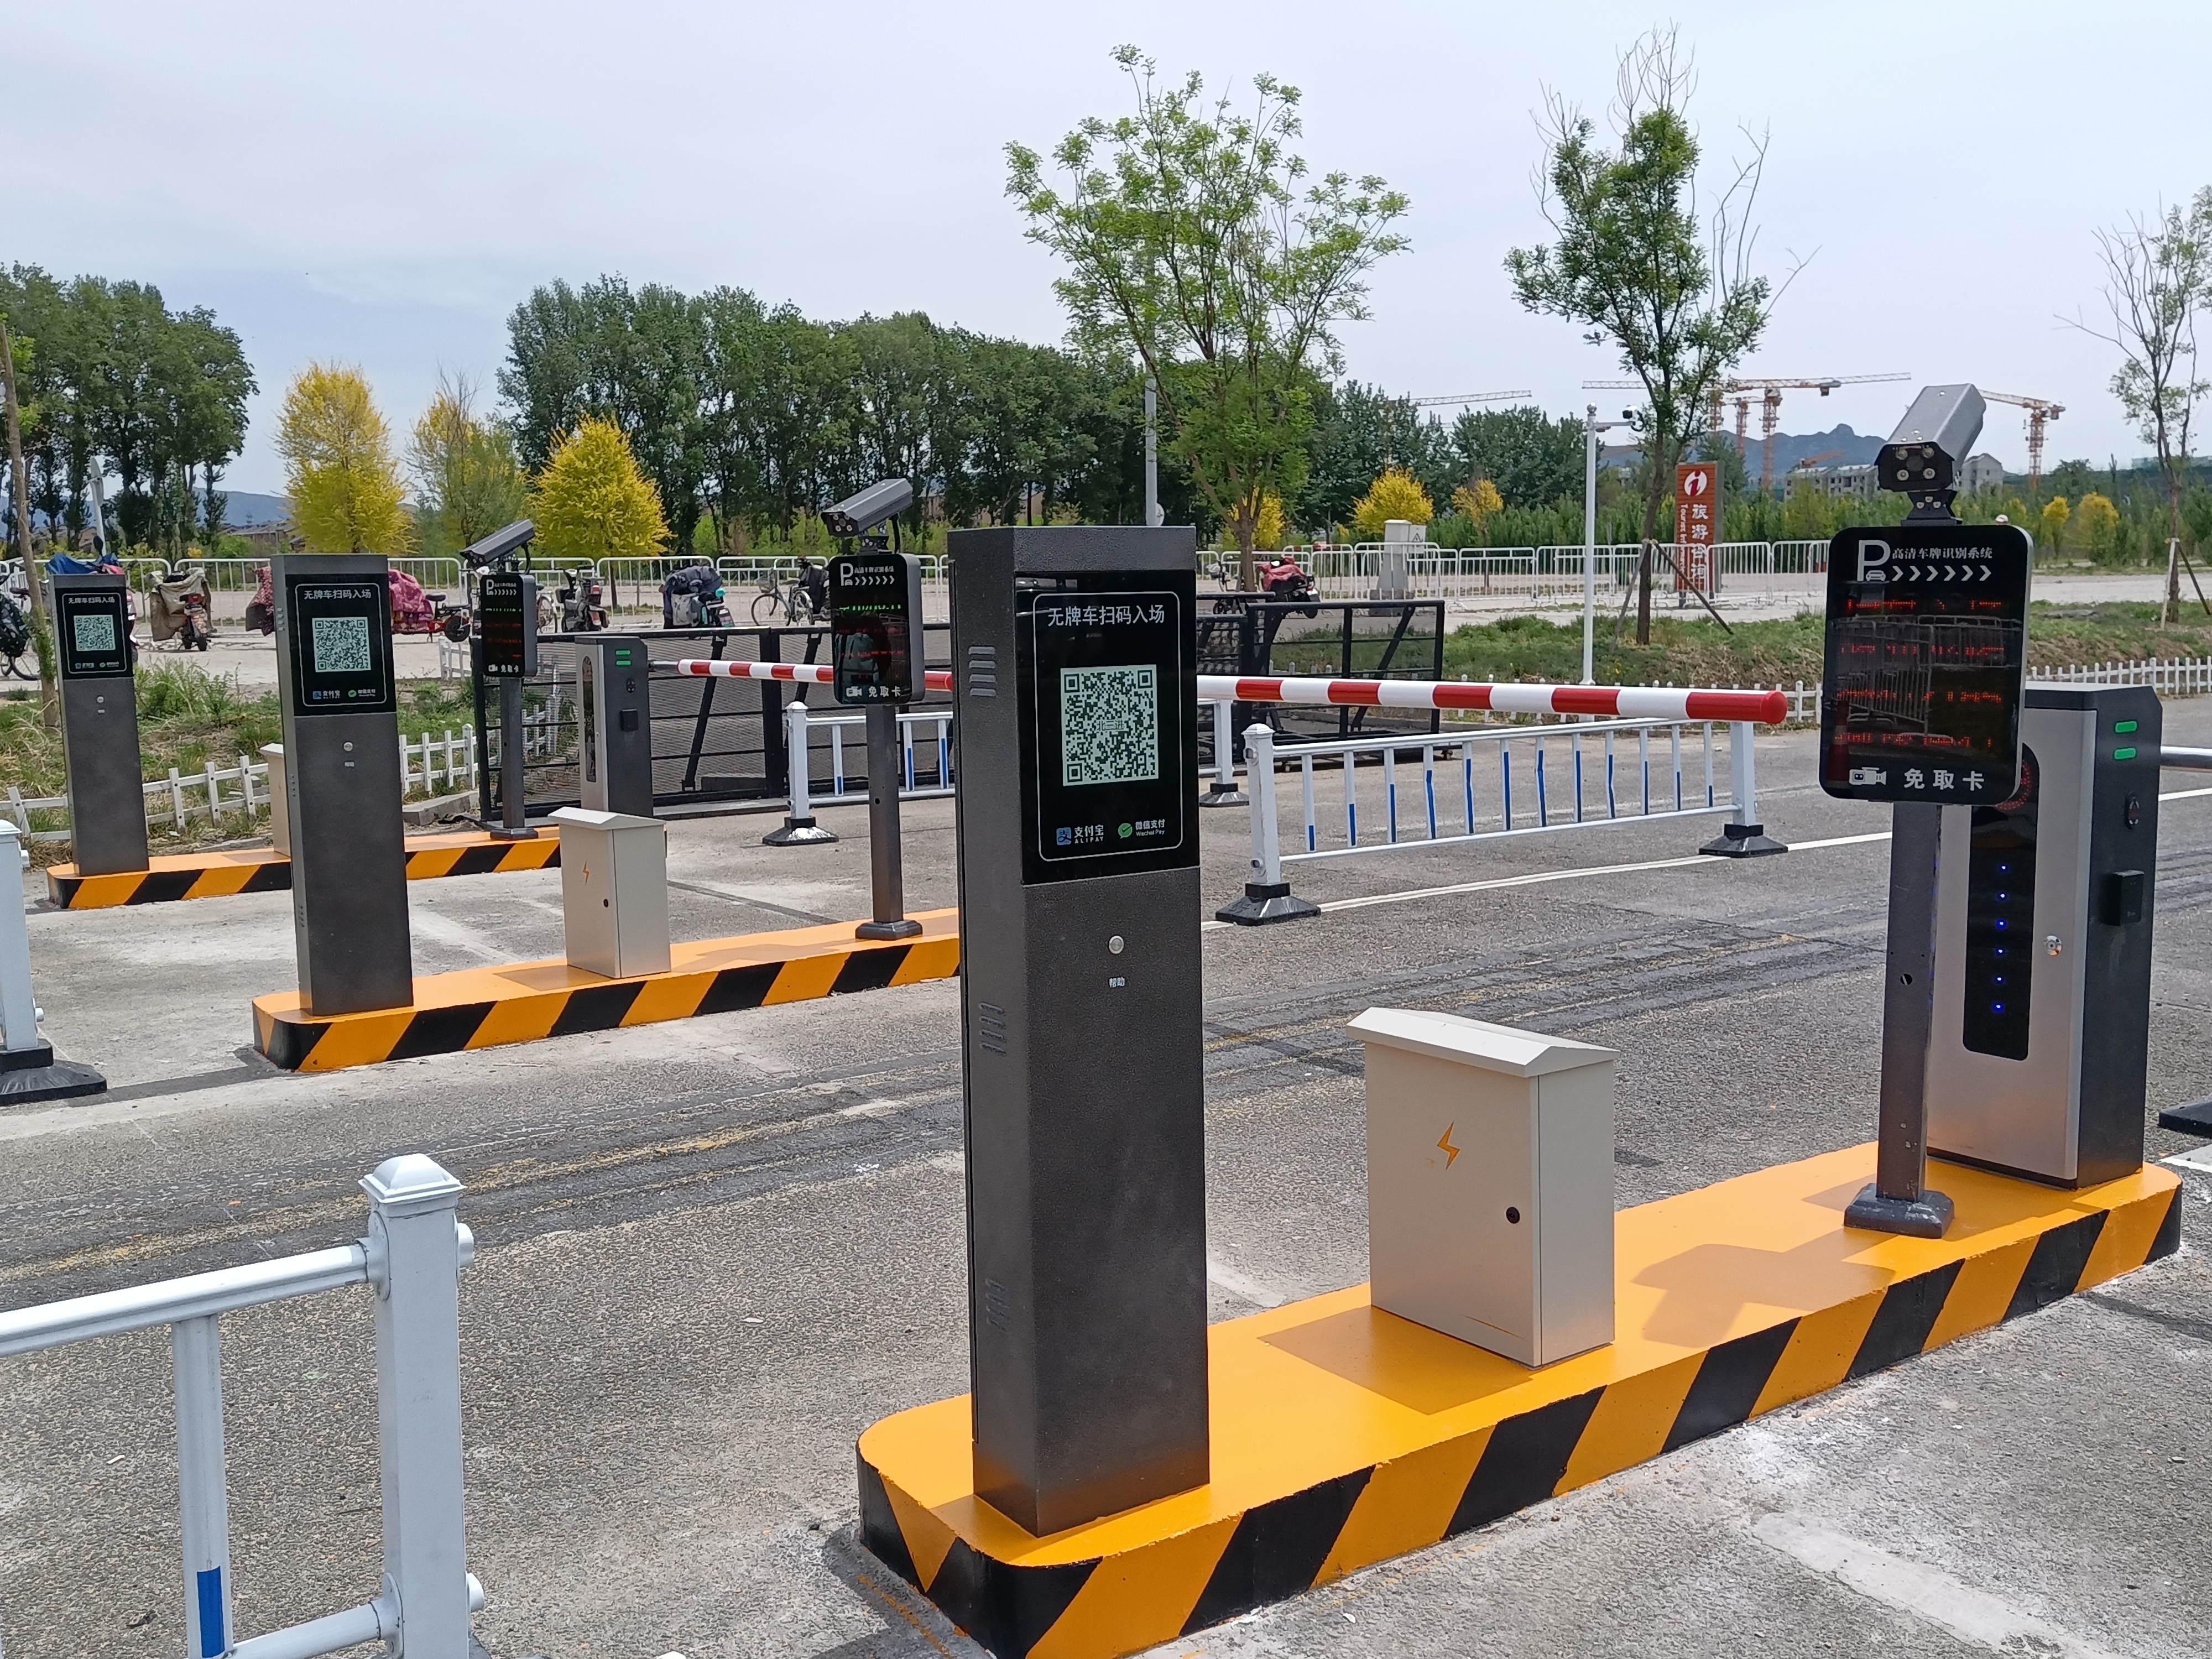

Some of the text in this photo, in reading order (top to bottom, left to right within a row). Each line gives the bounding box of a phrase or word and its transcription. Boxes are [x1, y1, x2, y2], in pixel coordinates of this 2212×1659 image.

[1857, 539, 1891, 581] P
[1892, 547, 1993, 560] 高清车牌识别系统
[304, 589, 372, 599] 无牌车扫码入场
[1048, 605, 1165, 627] 无牌车扫码入场
[869, 686, 901, 697] 免取卡
[1904, 768, 1985, 791] 免取卡
[1135, 819, 1165, 830] 微信支付
[1074, 825, 1104, 838] 支付宝
[1074, 836, 1104, 844] ALIPAY
